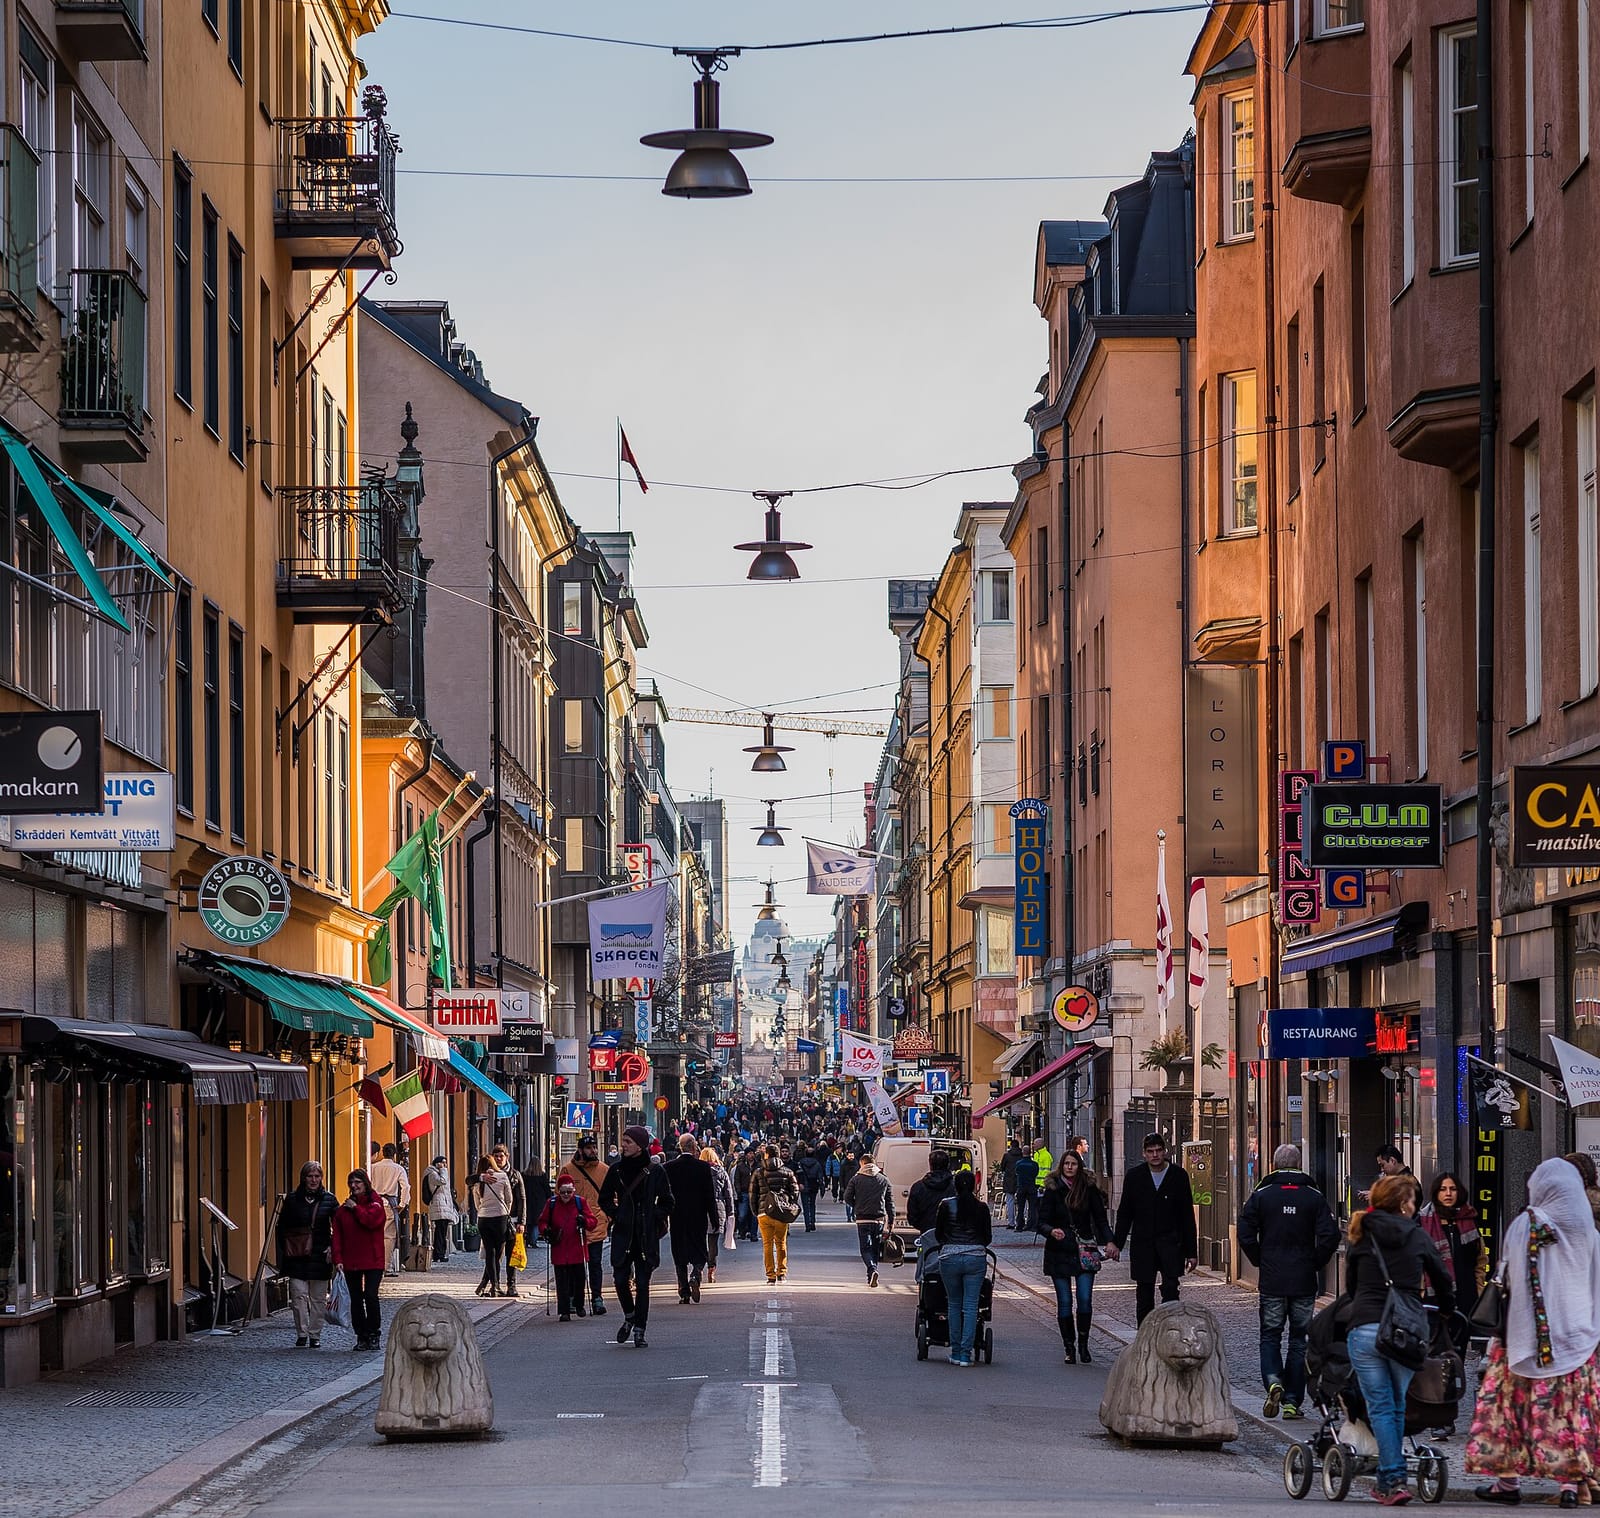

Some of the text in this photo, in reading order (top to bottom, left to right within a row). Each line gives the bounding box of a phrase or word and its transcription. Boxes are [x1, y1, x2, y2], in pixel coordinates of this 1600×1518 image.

[14, 829, 160, 840] Skrädderi Kemtvätt Vittvätt
[1323, 835, 1430, 848] Clubwear
[206, 861, 282, 896] ESPRESSO
[818, 877, 862, 887] AUDERE
[1018, 827, 1041, 948] HOTEL
[212, 918, 272, 940] HOUSE
[595, 950, 659, 963] SKAGEN
[634, 962, 659, 970] fonder
[858, 940, 867, 1029] APOTEK
[437, 999, 499, 1026] CHINA
[509, 1026, 541, 1036] Solution
[1283, 1028, 1358, 1040] RESTAURANG
[853, 1047, 876, 1060] ICA
[1283, 1206, 1296, 1214] HH
